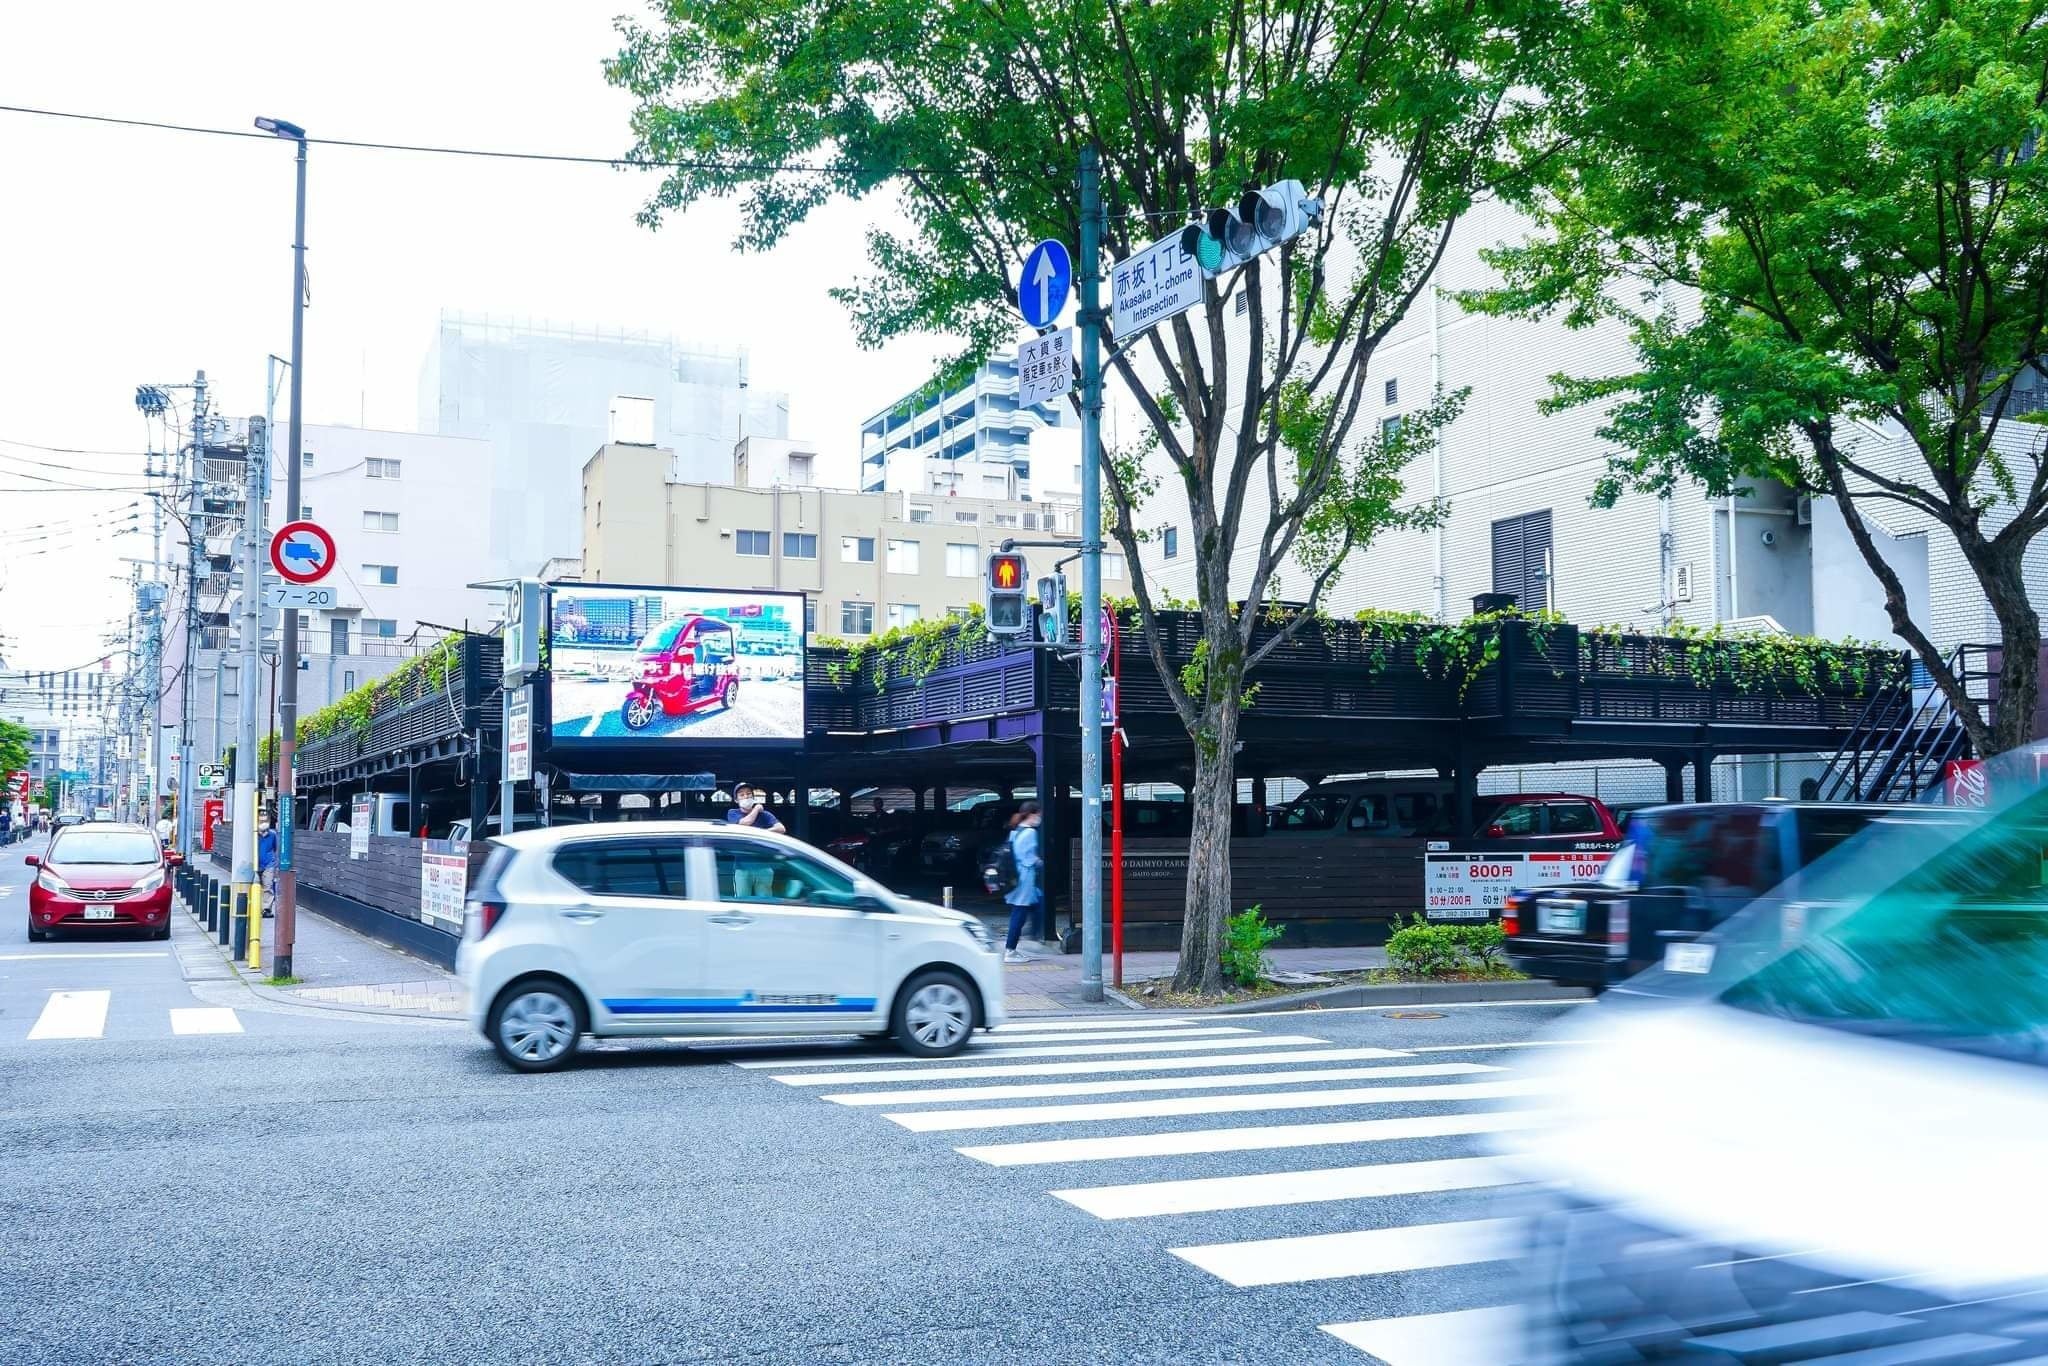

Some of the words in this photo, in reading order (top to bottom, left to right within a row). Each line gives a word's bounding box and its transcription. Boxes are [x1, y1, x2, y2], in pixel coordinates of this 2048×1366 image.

[1120, 288, 1152, 313] Akasaka
[1155, 268, 1193, 296] 1-chome
[1133, 293, 1179, 323] Intersection
[1023, 356, 1067, 383] 指定車を除く
[1102, 860, 1128, 868] DAO
[1129, 859, 1162, 868] DAIMYO
[1469, 864, 1513, 878] 800円
